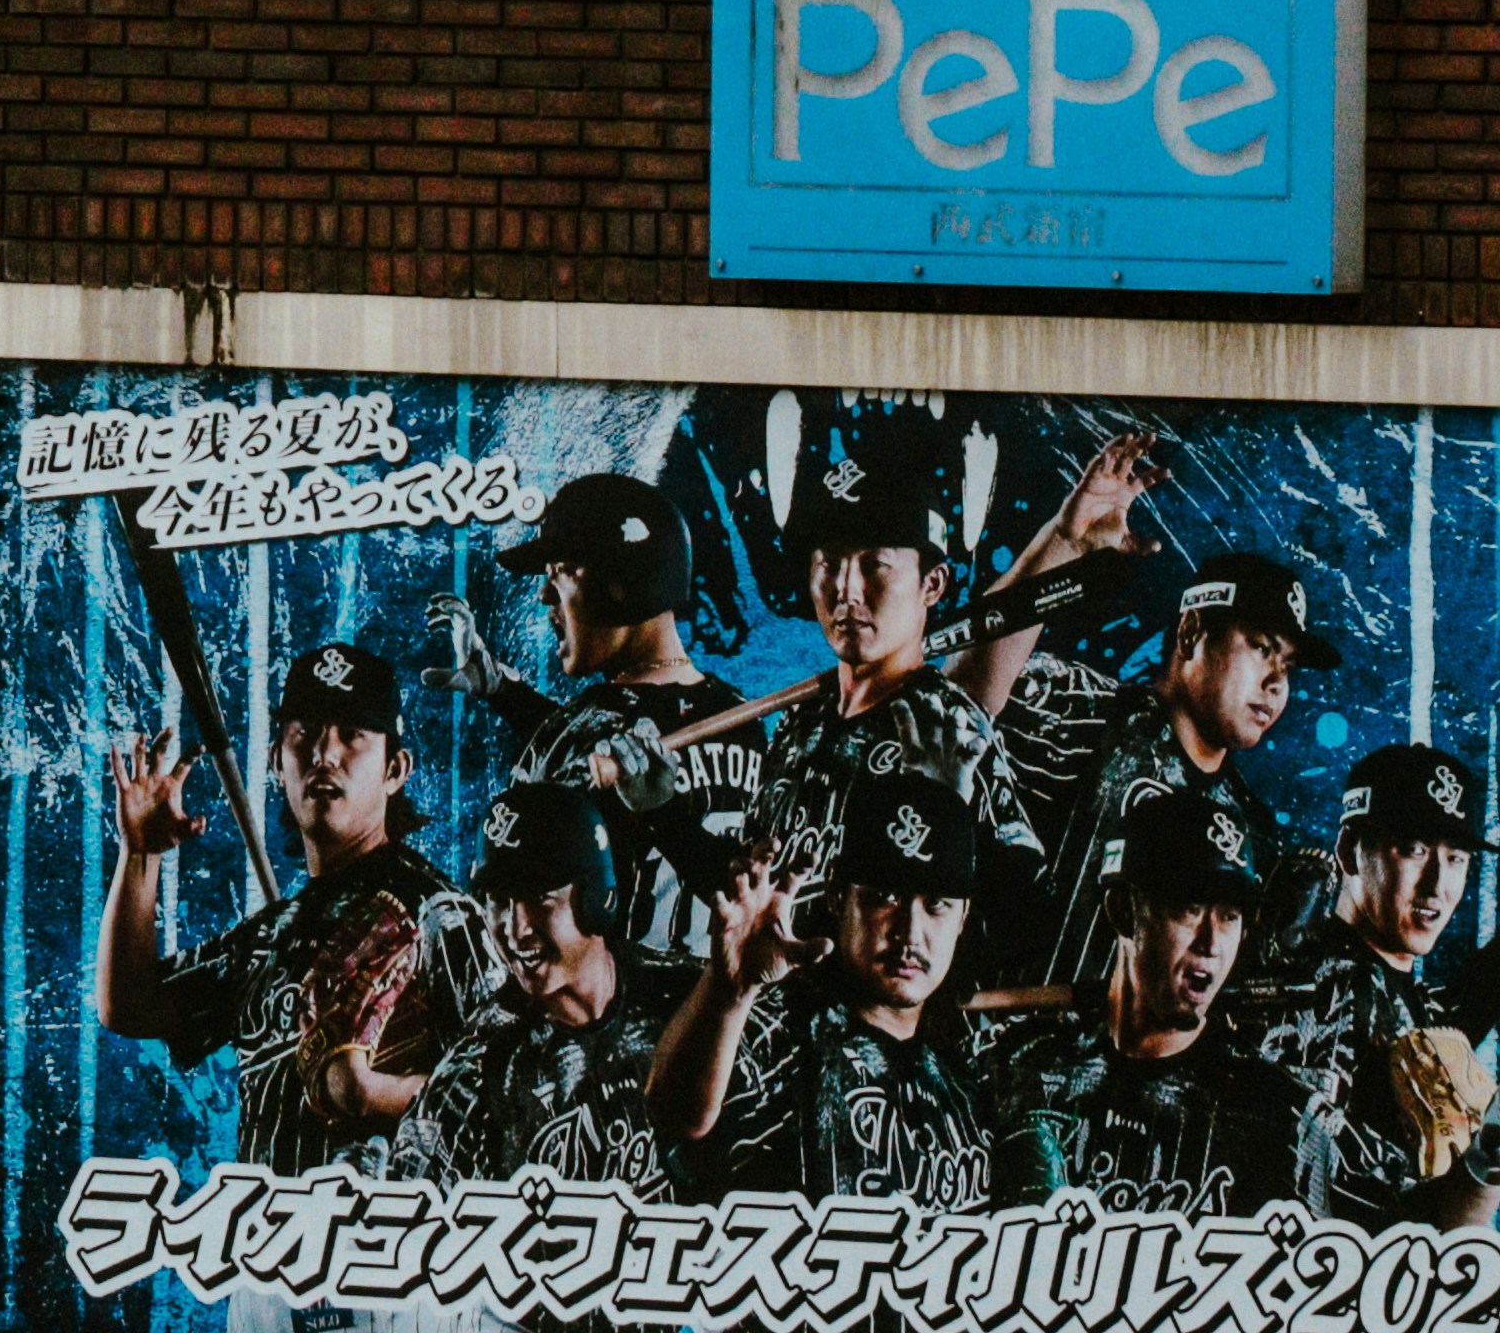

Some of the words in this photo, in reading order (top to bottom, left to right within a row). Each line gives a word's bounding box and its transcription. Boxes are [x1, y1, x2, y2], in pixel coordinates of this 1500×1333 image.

[25, 400, 406, 479] 記憶に残る夏が、
[149, 463, 538, 535] 今年もやってくる。
